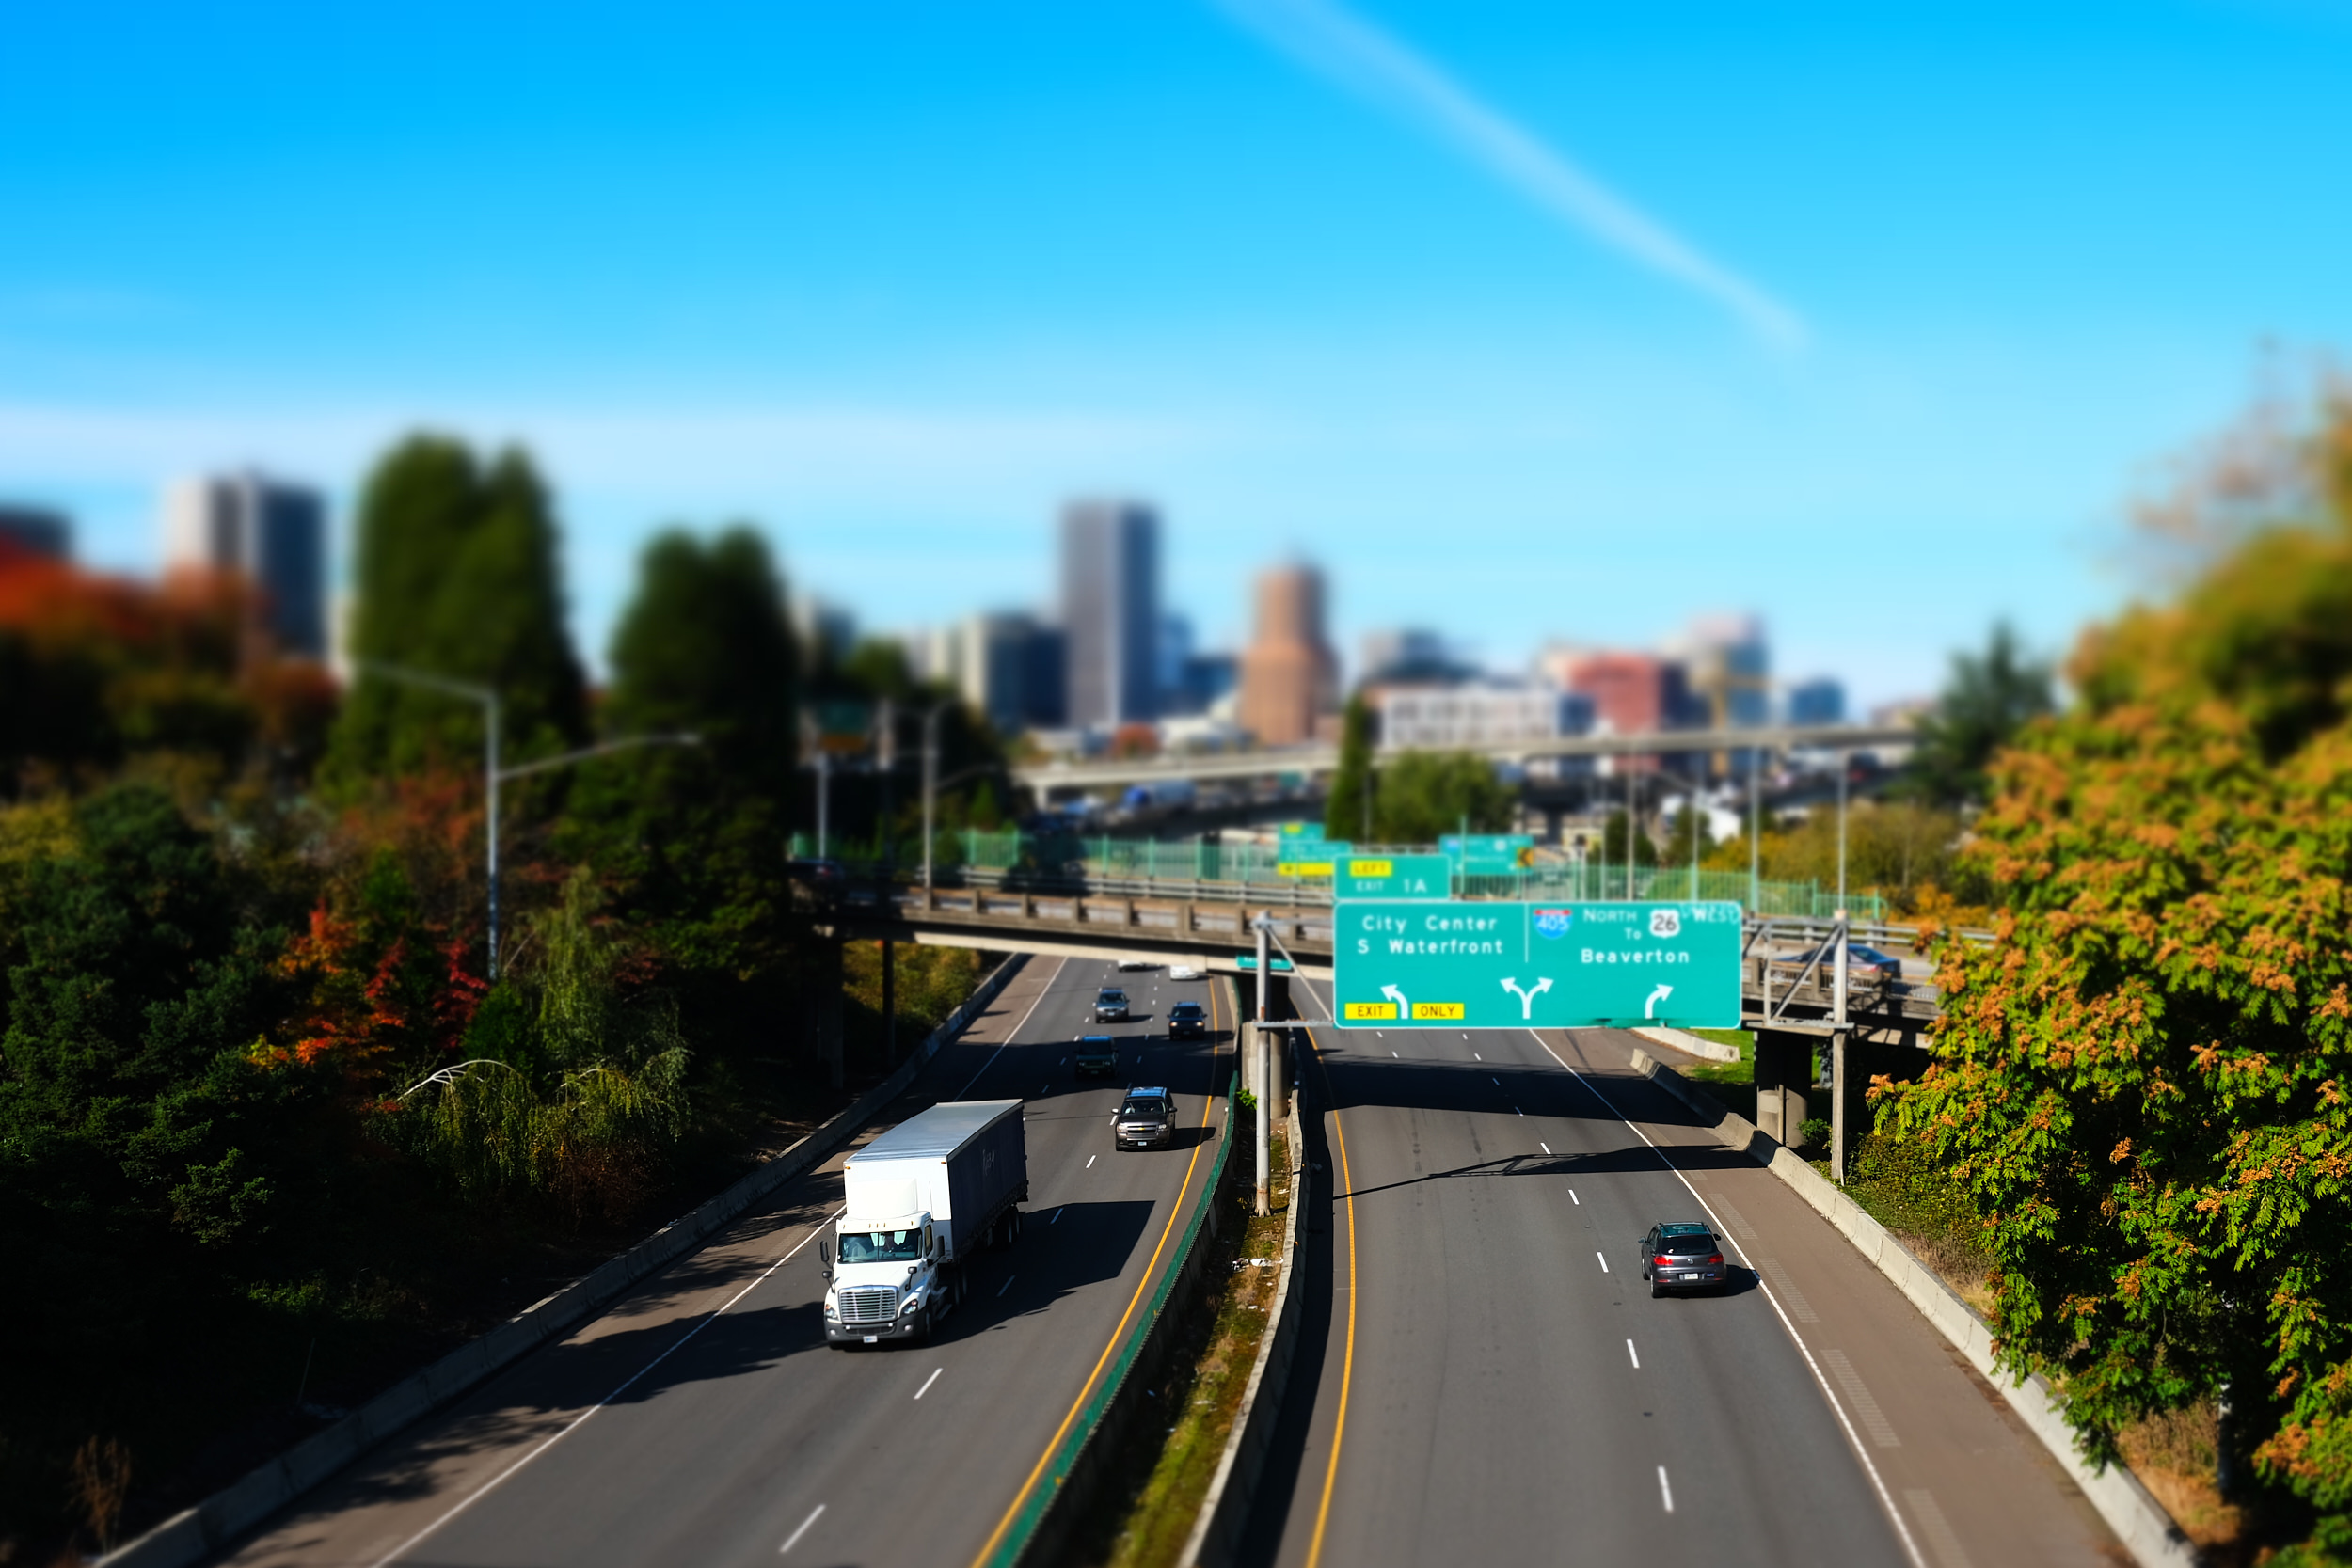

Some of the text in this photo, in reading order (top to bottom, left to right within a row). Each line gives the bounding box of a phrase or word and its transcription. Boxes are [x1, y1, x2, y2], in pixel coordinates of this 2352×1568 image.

[1353, 862, 1387, 875] LEFT
[1356, 879, 1385, 892] EXIT
[1362, 914, 1497, 935] City Center
[1537, 914, 1569, 930] 405
[1653, 912, 1677, 932] 26
[1357, 938, 1502, 955] S Waterfront
[1581, 947, 1690, 964] Beaverton
[1357, 1005, 1455, 1017] EXIT ONLY
